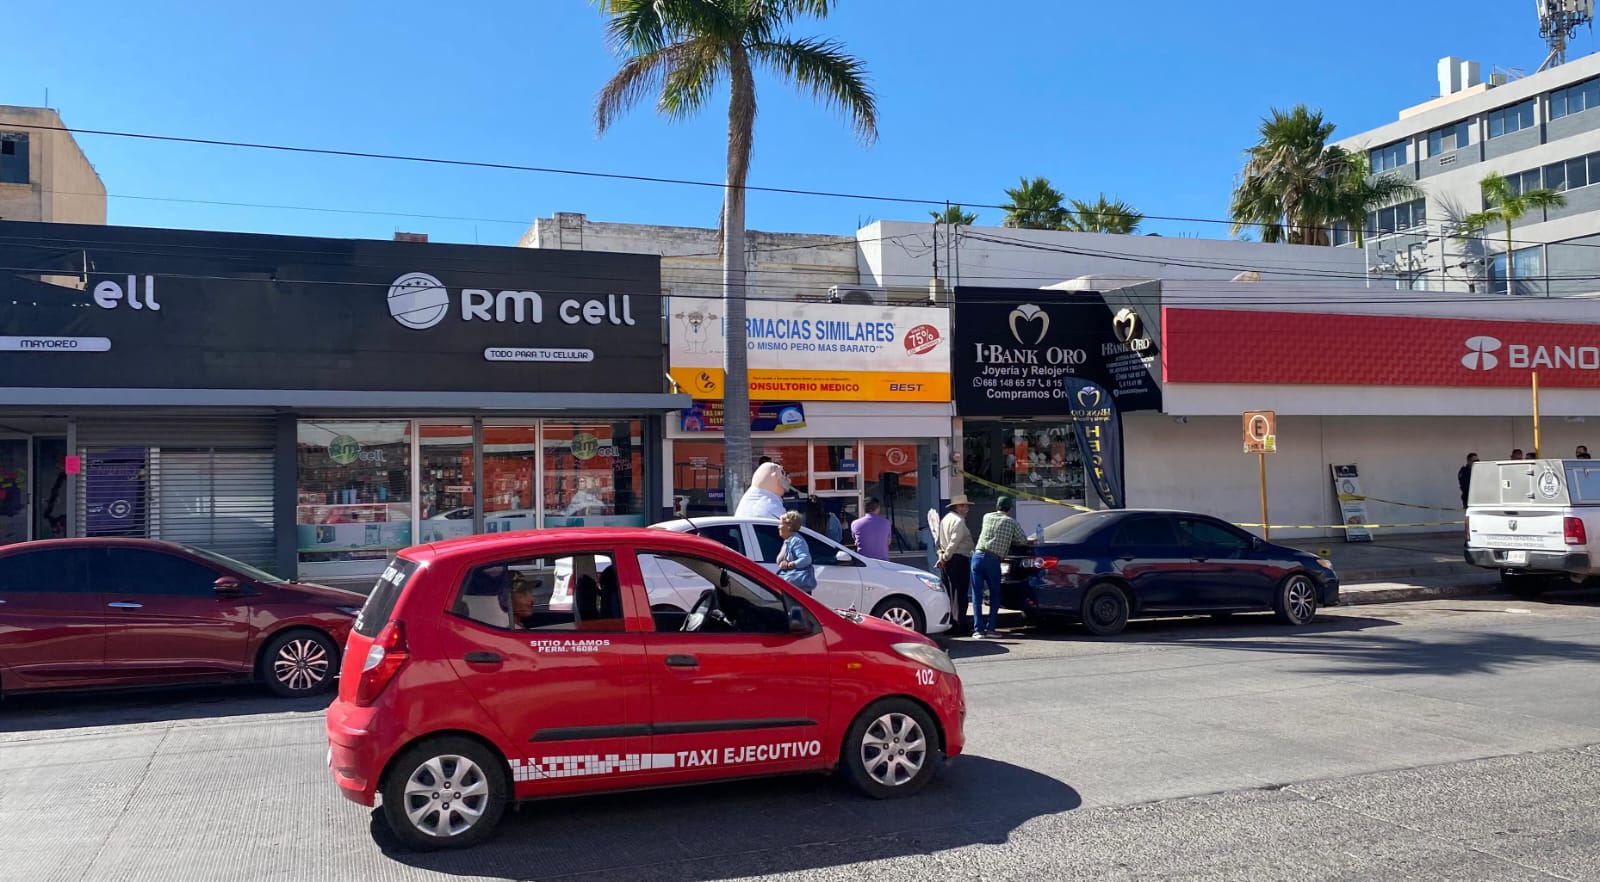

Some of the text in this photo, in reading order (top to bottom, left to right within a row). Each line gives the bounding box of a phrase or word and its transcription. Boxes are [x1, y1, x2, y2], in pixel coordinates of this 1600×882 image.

[559, 293, 636, 326] cell
[721, 316, 895, 342] RMACIAS SIMILARES
[20, 339, 78, 348] MAYOREO
[908, 329, 934, 347] 75%
[490, 350, 513, 358] TODO
[515, 350, 537, 358] PARA
[553, 351, 589, 359] CELULAR
[757, 342, 788, 350] MISMO
[790, 343, 816, 351] PERO
[818, 344, 838, 352] MAS
[1046, 346, 1087, 365] ORO
[1022, 367, 1029, 378] y
[748, 382, 860, 392] ONSULTORIO MEDICO
[889, 383, 923, 392] BEST
[986, 388, 1050, 401] Compramos
[1255, 419, 1264, 437] E
[915, 668, 935, 685] 102
[677, 740, 821, 768] TAXI EJECUTIVO
